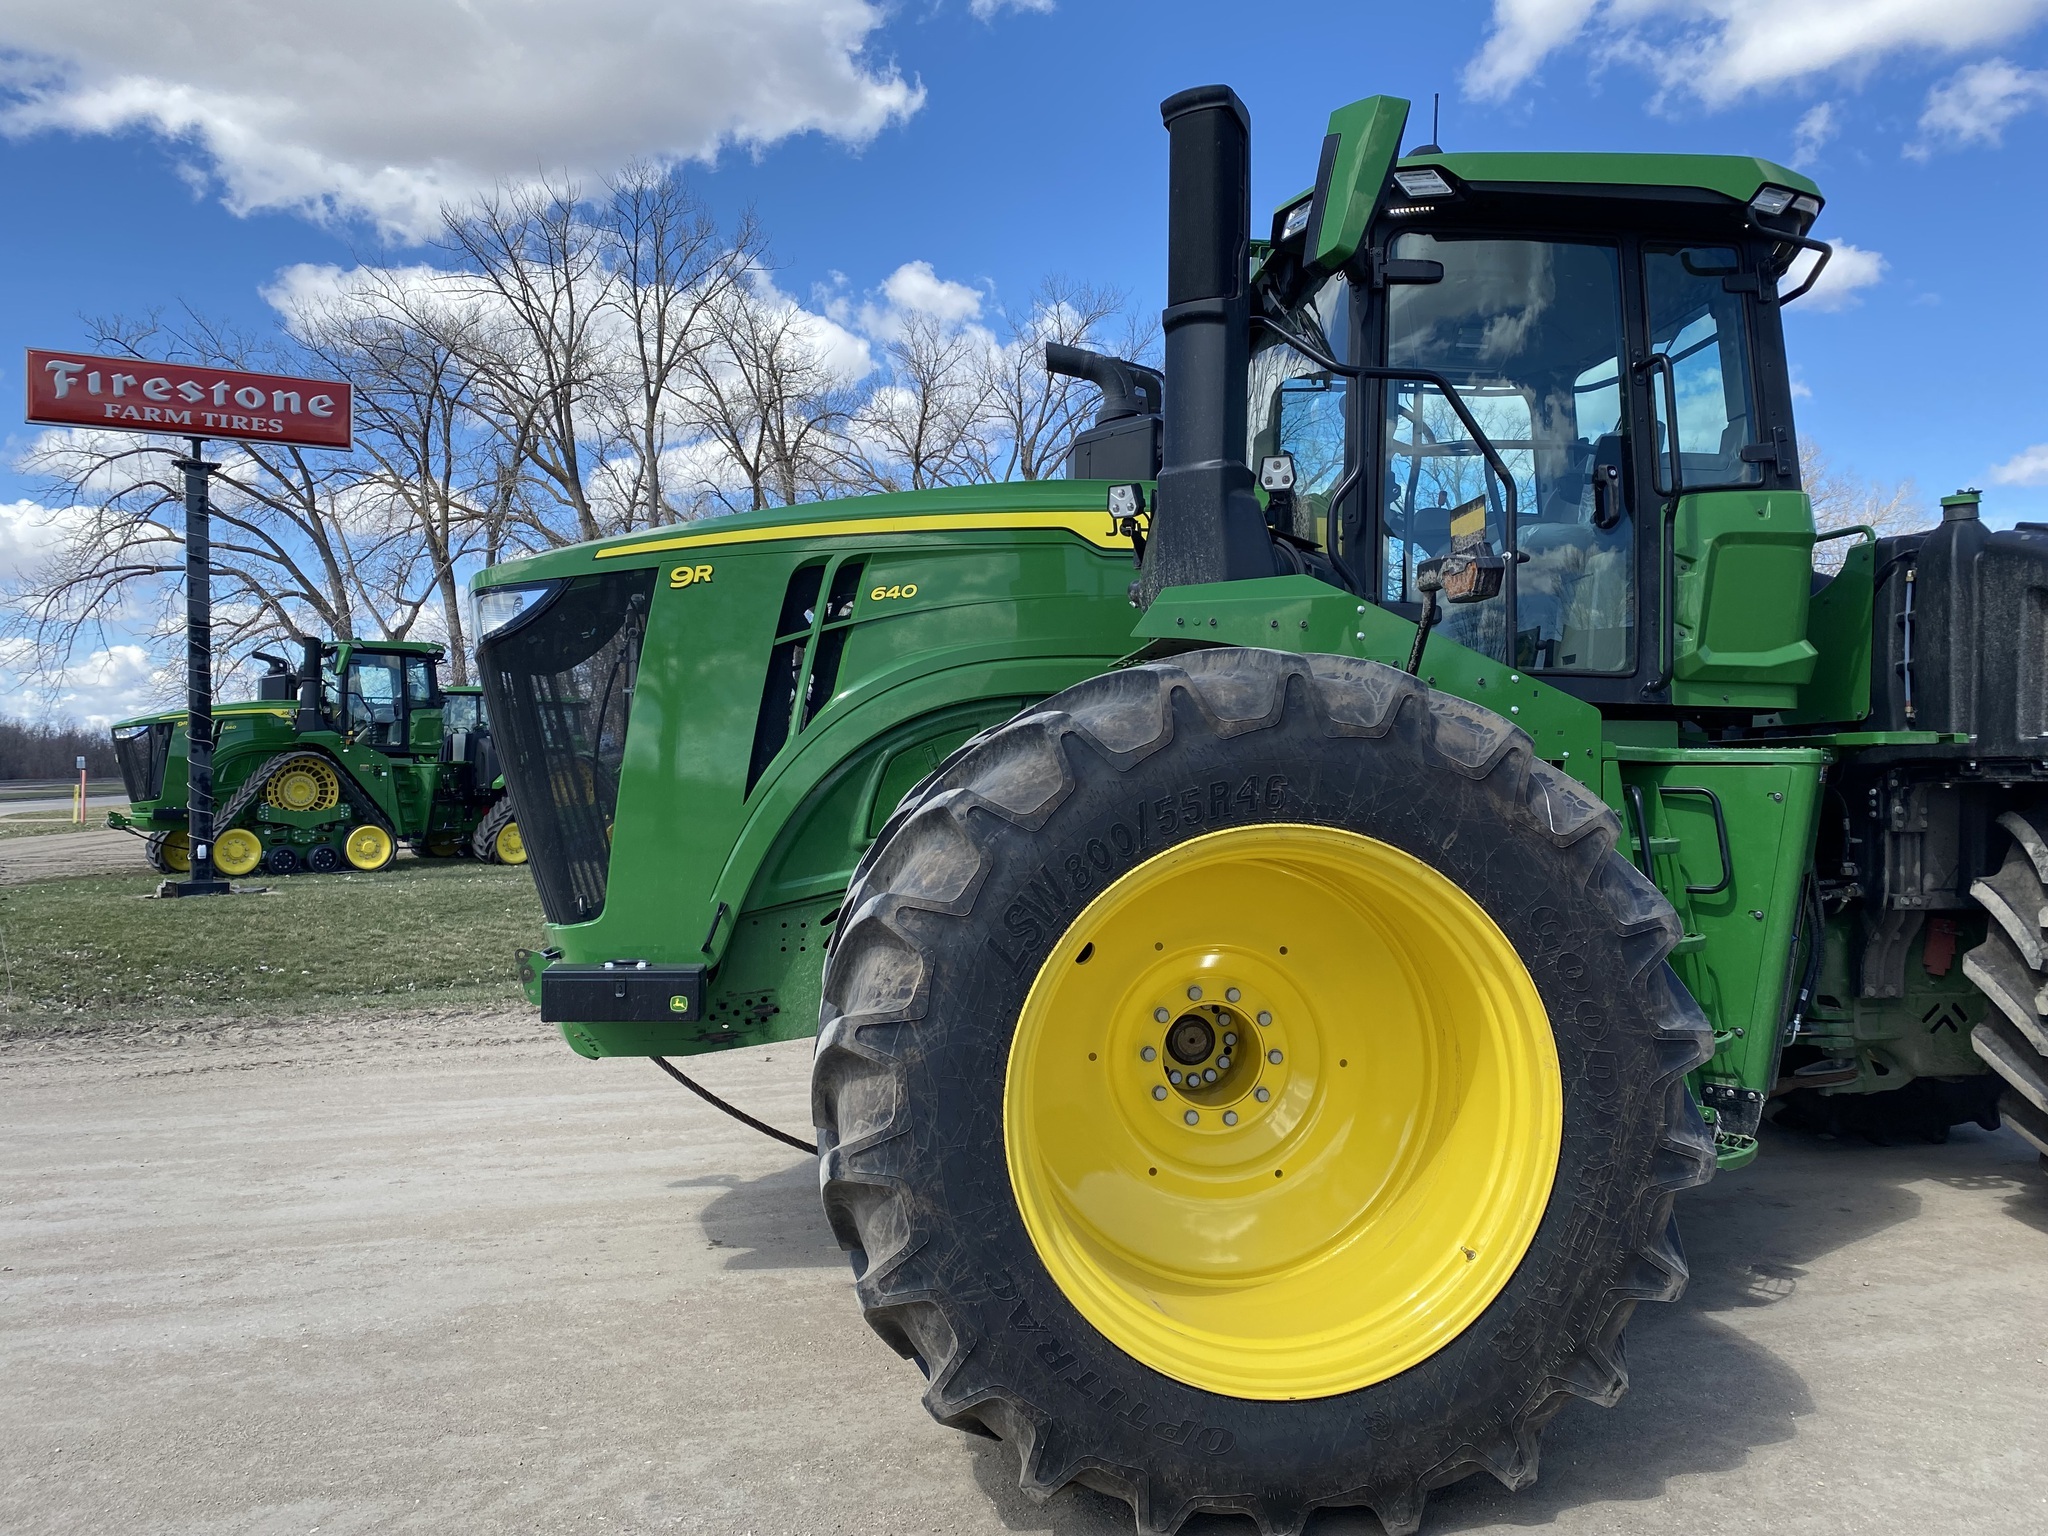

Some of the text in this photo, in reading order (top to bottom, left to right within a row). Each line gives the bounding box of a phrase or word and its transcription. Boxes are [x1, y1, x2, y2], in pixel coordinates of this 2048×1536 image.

[44, 359, 336, 418] Firestone
[103, 402, 284, 434] FARM TIRES
[669, 564, 714, 589] 9R
[870, 583, 919, 602] 640
[984, 1268, 1237, 1456] OPTITRAC
